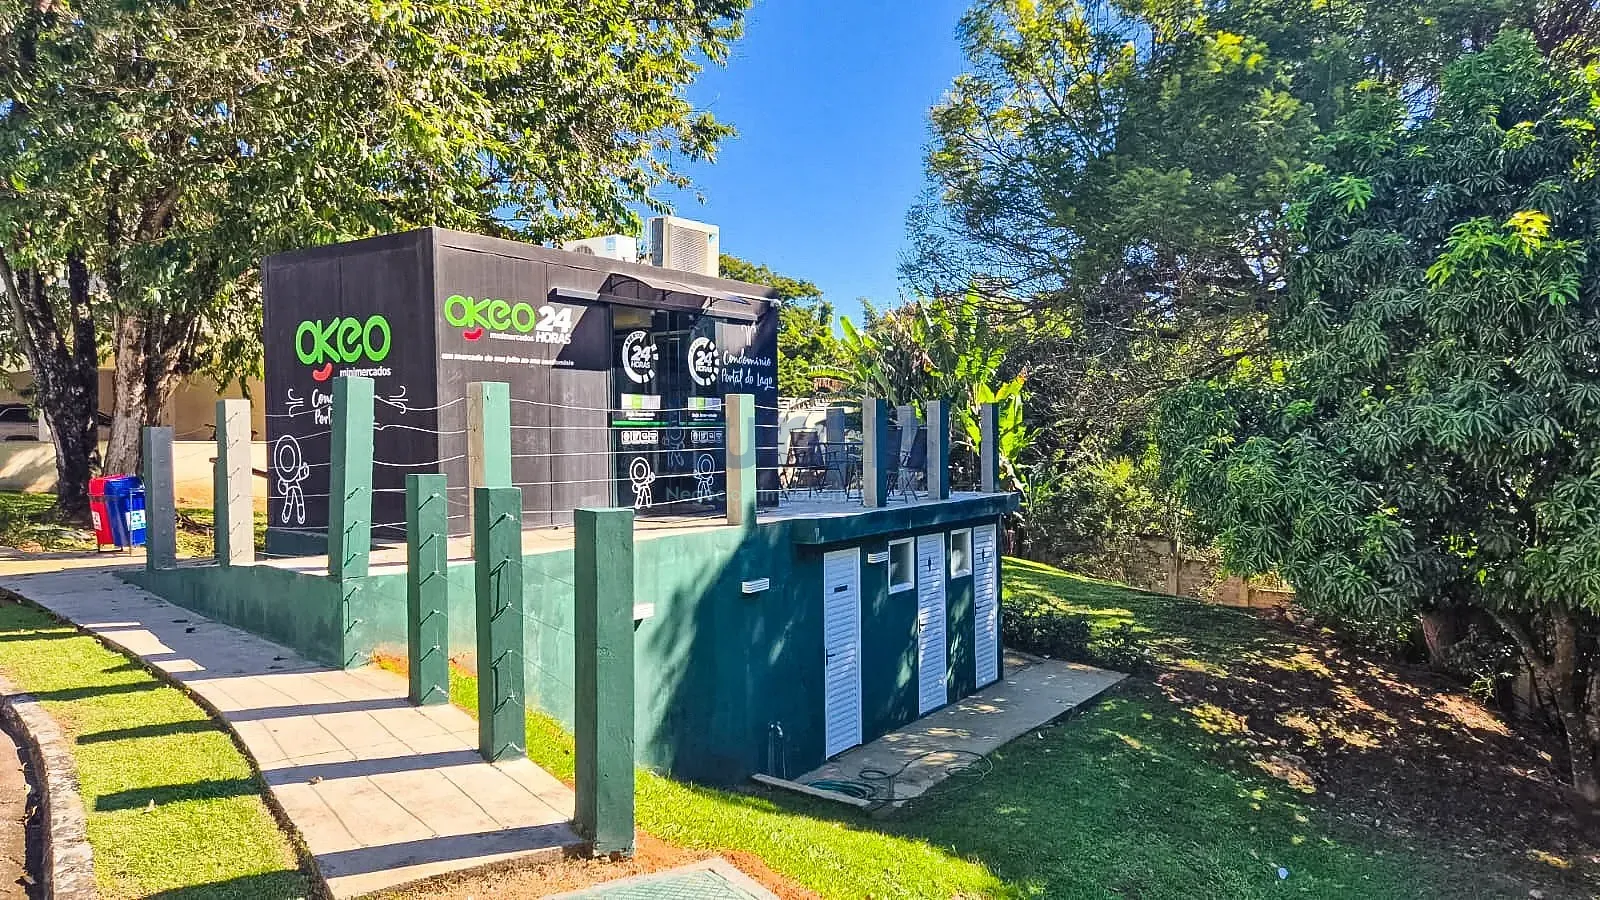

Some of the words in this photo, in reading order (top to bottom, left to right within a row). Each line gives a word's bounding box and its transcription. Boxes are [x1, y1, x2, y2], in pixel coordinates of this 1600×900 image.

[535, 305, 573, 331] 24
[536, 331, 572, 345] HORAS
[631, 345, 651, 361] 24
[696, 350, 712, 366] 24
[339, 365, 392, 377] minimercados
[745, 368, 754, 384] do
